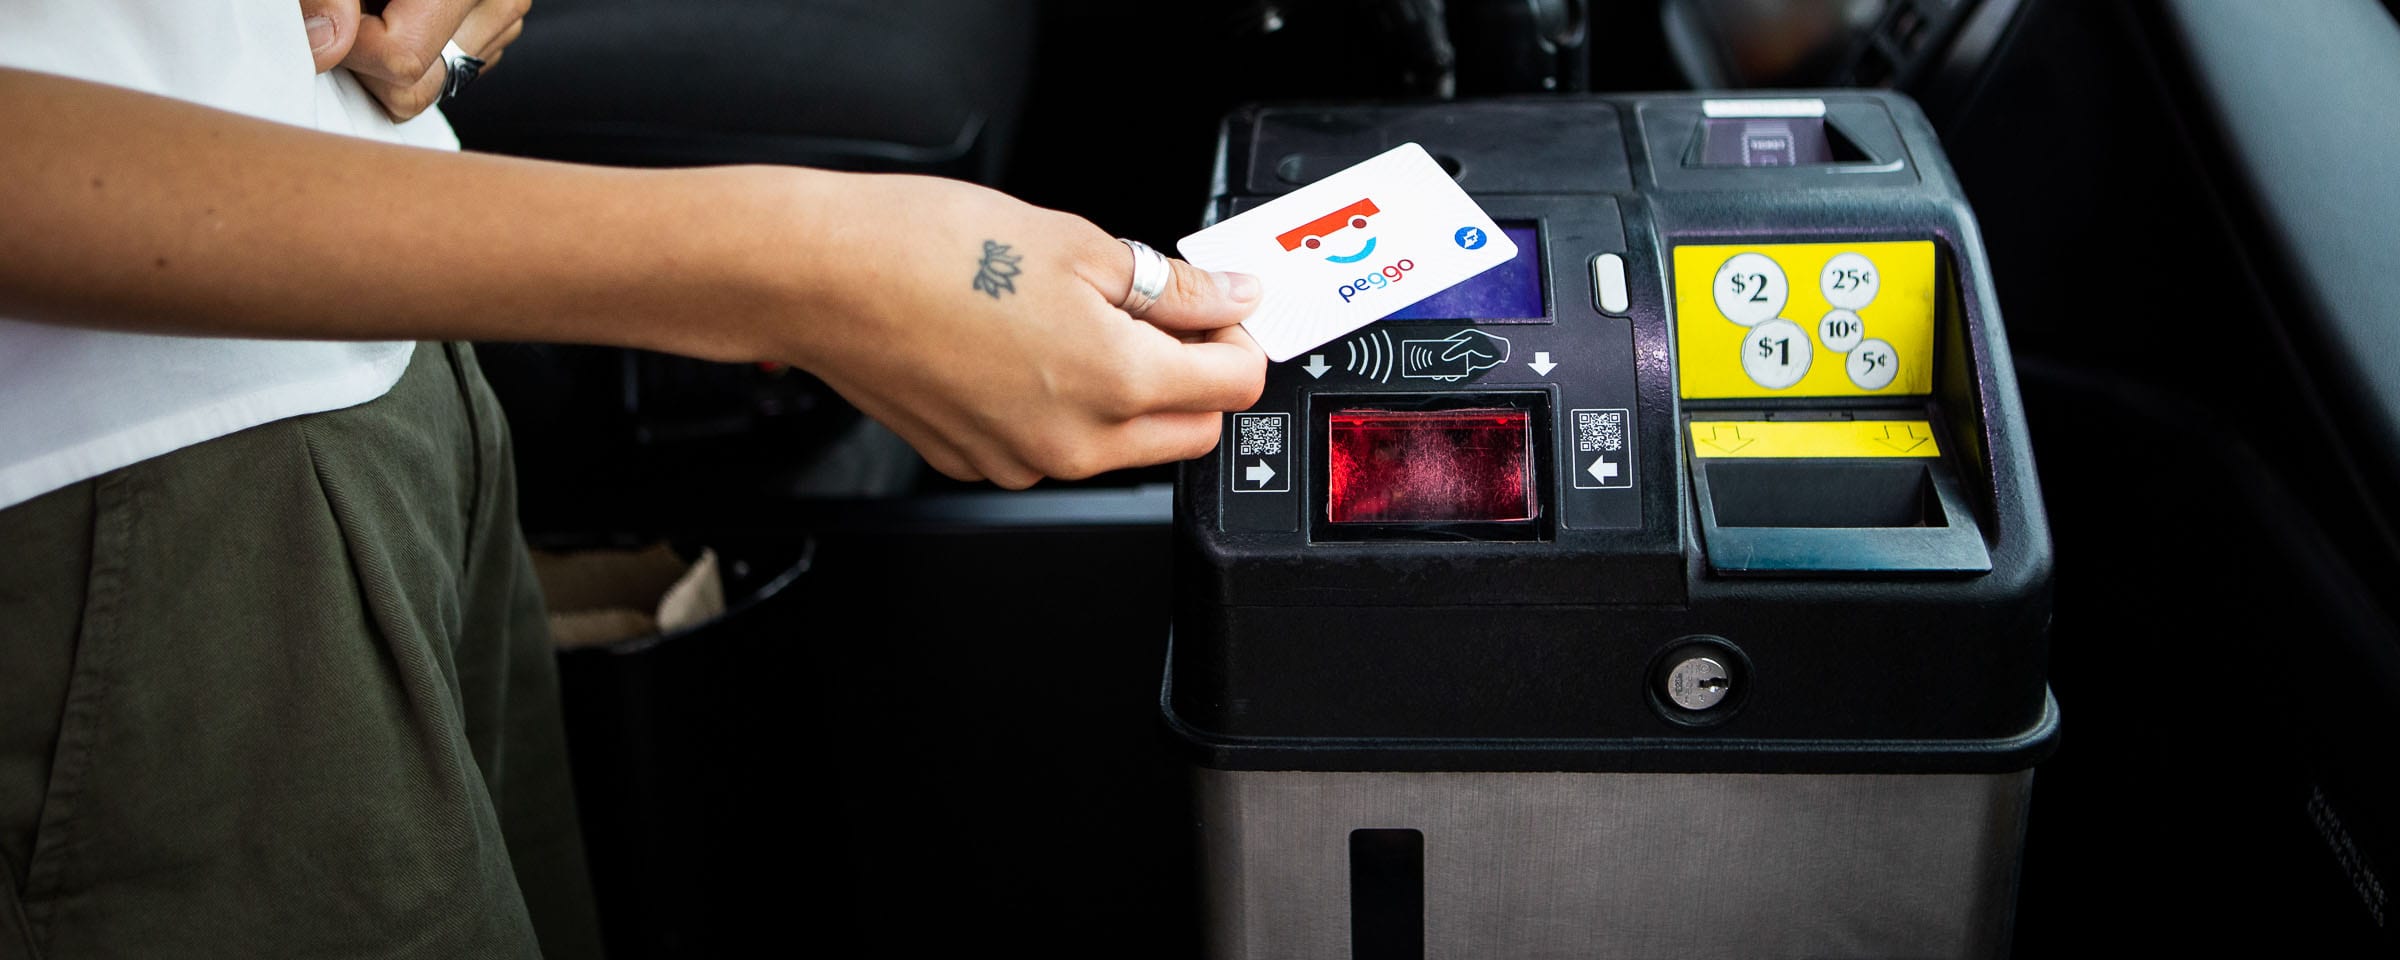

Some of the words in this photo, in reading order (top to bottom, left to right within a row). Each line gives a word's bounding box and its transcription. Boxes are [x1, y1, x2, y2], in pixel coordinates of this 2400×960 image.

[1338, 259, 1414, 303] peggo
[1731, 273, 1768, 302] $2
[1832, 269, 1871, 291] 25¢
[1828, 320, 1857, 338] 10¢
[1758, 336, 1790, 366] $1
[1862, 352, 1888, 375] 5¢
